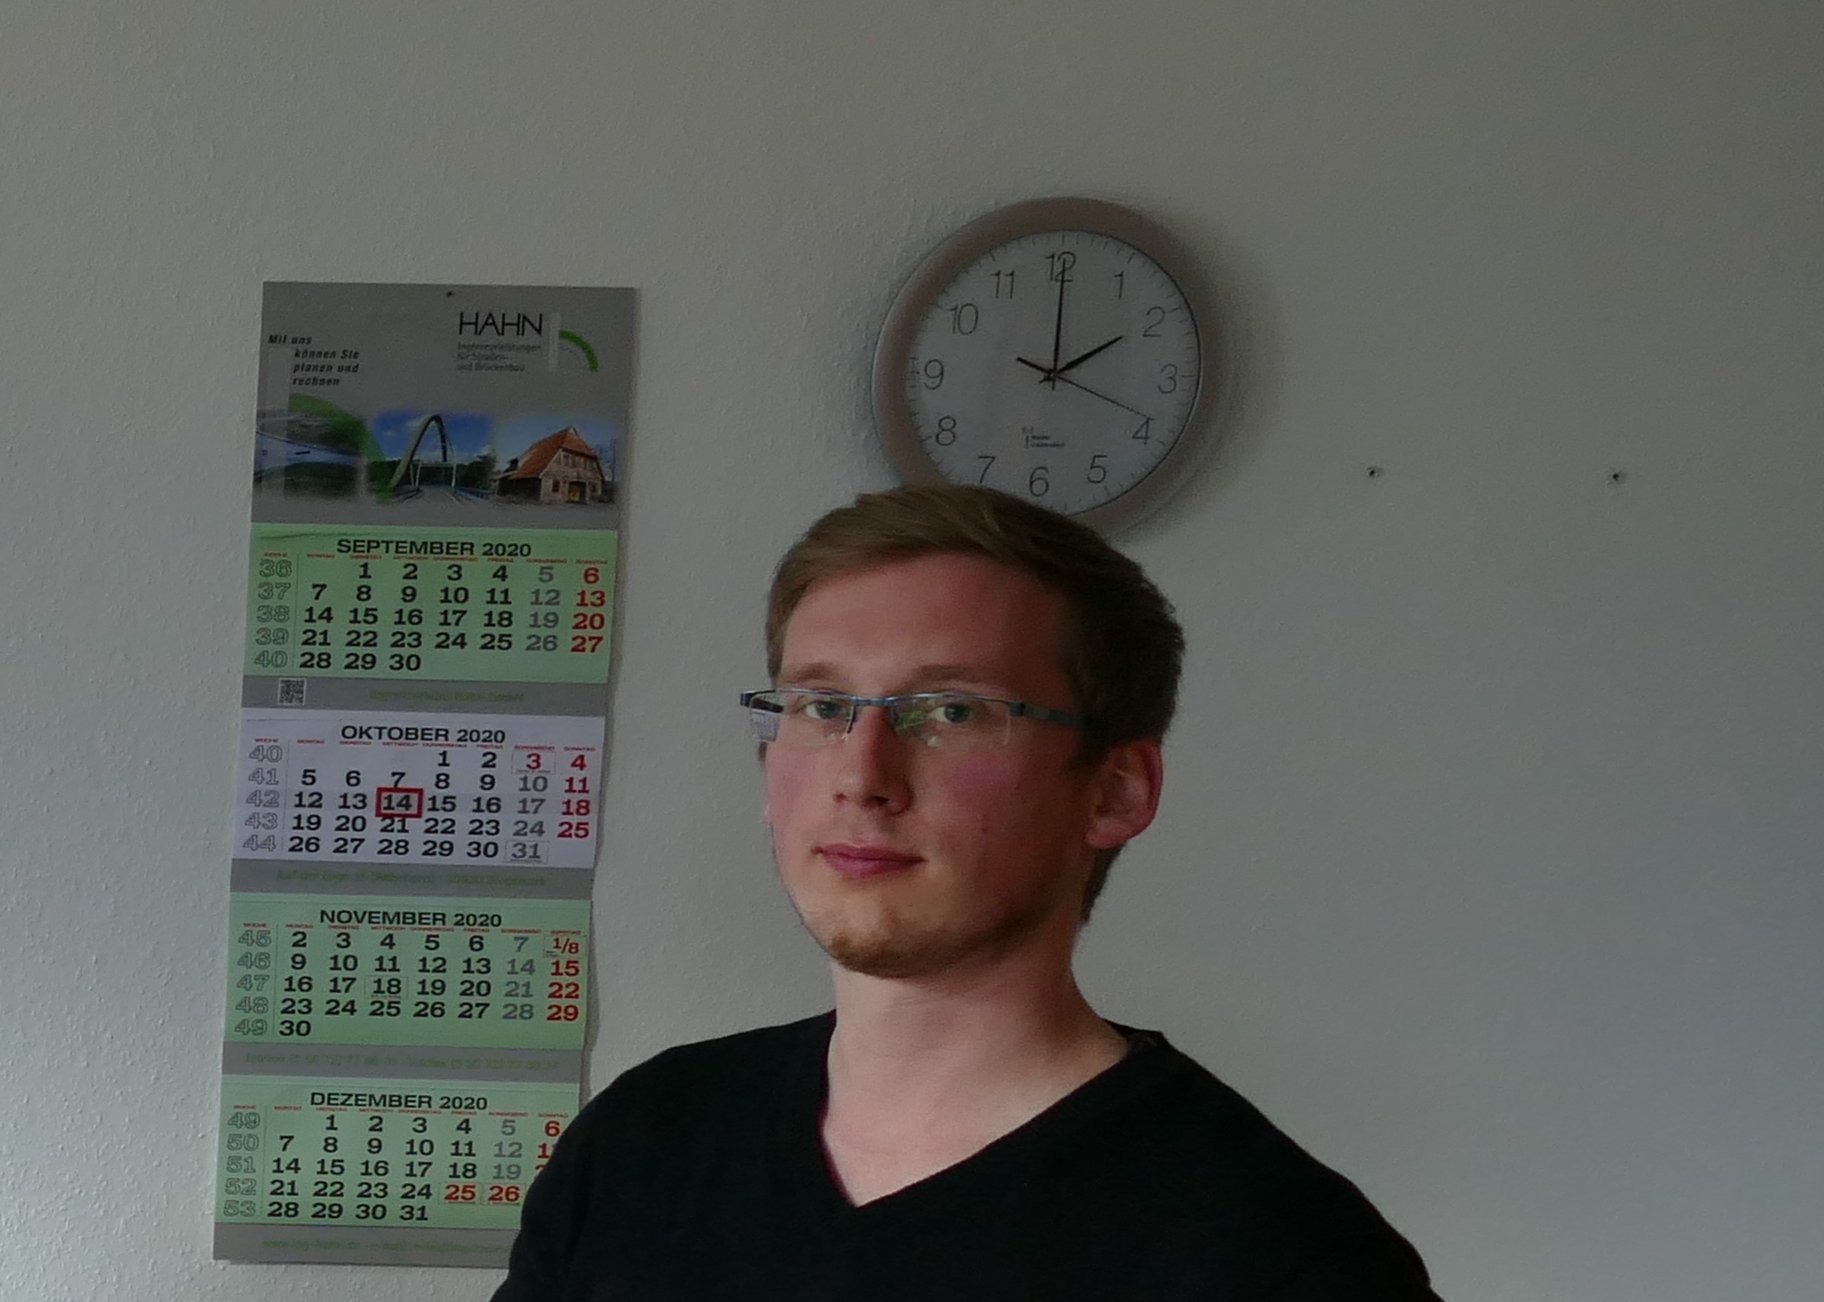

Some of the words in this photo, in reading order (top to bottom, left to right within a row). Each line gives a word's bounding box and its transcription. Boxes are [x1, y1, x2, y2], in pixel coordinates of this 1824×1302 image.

[1045, 251, 1077, 283] 12
[990, 270, 1015, 299] 11
[1114, 271, 1124, 299] 1
[457, 312, 543, 337] HAHN
[949, 303, 979, 335] 10
[1142, 306, 1166, 338] 2
[267, 334, 288, 345] Mit
[291, 335, 312, 346] uns
[294, 349, 336, 360] können
[341, 350, 360, 360] Sie
[293, 362, 334, 374] planen
[337, 364, 359, 373] und
[923, 359, 945, 390] 9
[1157, 363, 1178, 394] 3
[292, 376, 340, 386] rechnen
[935, 415, 957, 446] 8
[1131, 418, 1152, 446] 4
[977, 455, 996, 484] 7
[1029, 466, 1049, 497] 6
[1087, 454, 1108, 484] 5
[336, 538, 475, 557] SEPTEMBER
[482, 542, 532, 558] 2020
[358, 562, 372, 580] 1
[402, 562, 419, 580] 2
[446, 563, 463, 582] 3
[492, 564, 509, 582] 4
[537, 565, 554, 584] 5
[583, 566, 600, 585] 6
[311, 583, 328, 601] 7
[355, 584, 372, 602] 8
[400, 585, 418, 603] 9
[439, 586, 470, 605] 10
[485, 587, 513, 605] 11
[529, 588, 561, 606] 12
[575, 589, 606, 608] 13
[340, 724, 450, 743] OKTOBER
[456, 728, 506, 744] 2020
[437, 750, 451, 767] 1
[481, 751, 497, 769] 2
[526, 752, 542, 771] 3
[570, 754, 587, 772] 4
[301, 768, 317, 786] 5
[345, 770, 361, 788] 6
[389, 771, 407, 789] 7
[434, 772, 451, 790] 8
[479, 773, 496, 791] 9
[518, 775, 548, 793] 10
[564, 776, 590, 794] 11
[293, 791, 323, 809] 12
[338, 792, 368, 810] 13
[382, 795, 413, 812] 14
[427, 794, 457, 813] 15
[471, 796, 502, 814] 16
[517, 797, 546, 815] 17
[561, 798, 591, 817] 18
[291, 813, 322, 831] 19
[334, 814, 367, 833] 20
[378, 817, 411, 834] 21
[423, 817, 456, 835] 22
[467, 818, 501, 837] 23
[512, 819, 545, 837] 24
[557, 821, 590, 839] 25
[287, 835, 321, 853] 26
[332, 836, 366, 854] 27
[376, 838, 410, 856] 28
[421, 839, 455, 857] 29
[466, 840, 499, 859] 30
[511, 842, 541, 860] 31
[319, 909, 447, 928] NOVEMBER
[453, 913, 502, 928] 2020
[291, 930, 307, 948] 2
[335, 931, 352, 949] 3
[379, 933, 397, 950] 4
[424, 934, 441, 951] 5
[468, 934, 485, 953] 6
[513, 936, 530, 953] 7
[552, 937, 579, 955] 1/8
[310, 1091, 433, 1110] DEZEMBER
[439, 1096, 488, 1111] 2020
[443, 1184, 476, 1201] 25
[487, 1185, 520, 1203] 26
